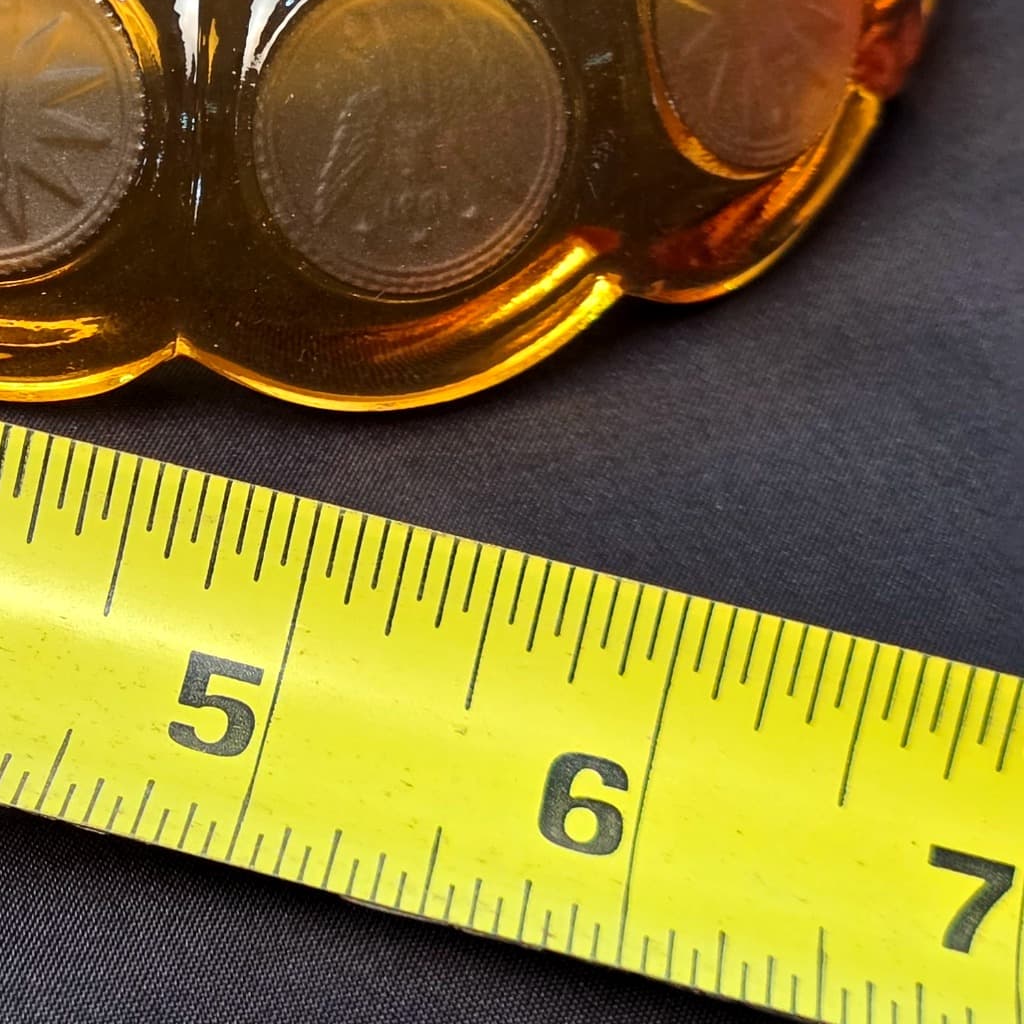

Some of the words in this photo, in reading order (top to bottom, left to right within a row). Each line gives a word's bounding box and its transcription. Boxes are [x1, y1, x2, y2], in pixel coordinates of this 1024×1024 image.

[168, 650, 265, 757] 5
[538, 751, 629, 856] 6
[928, 844, 1015, 954] 7
